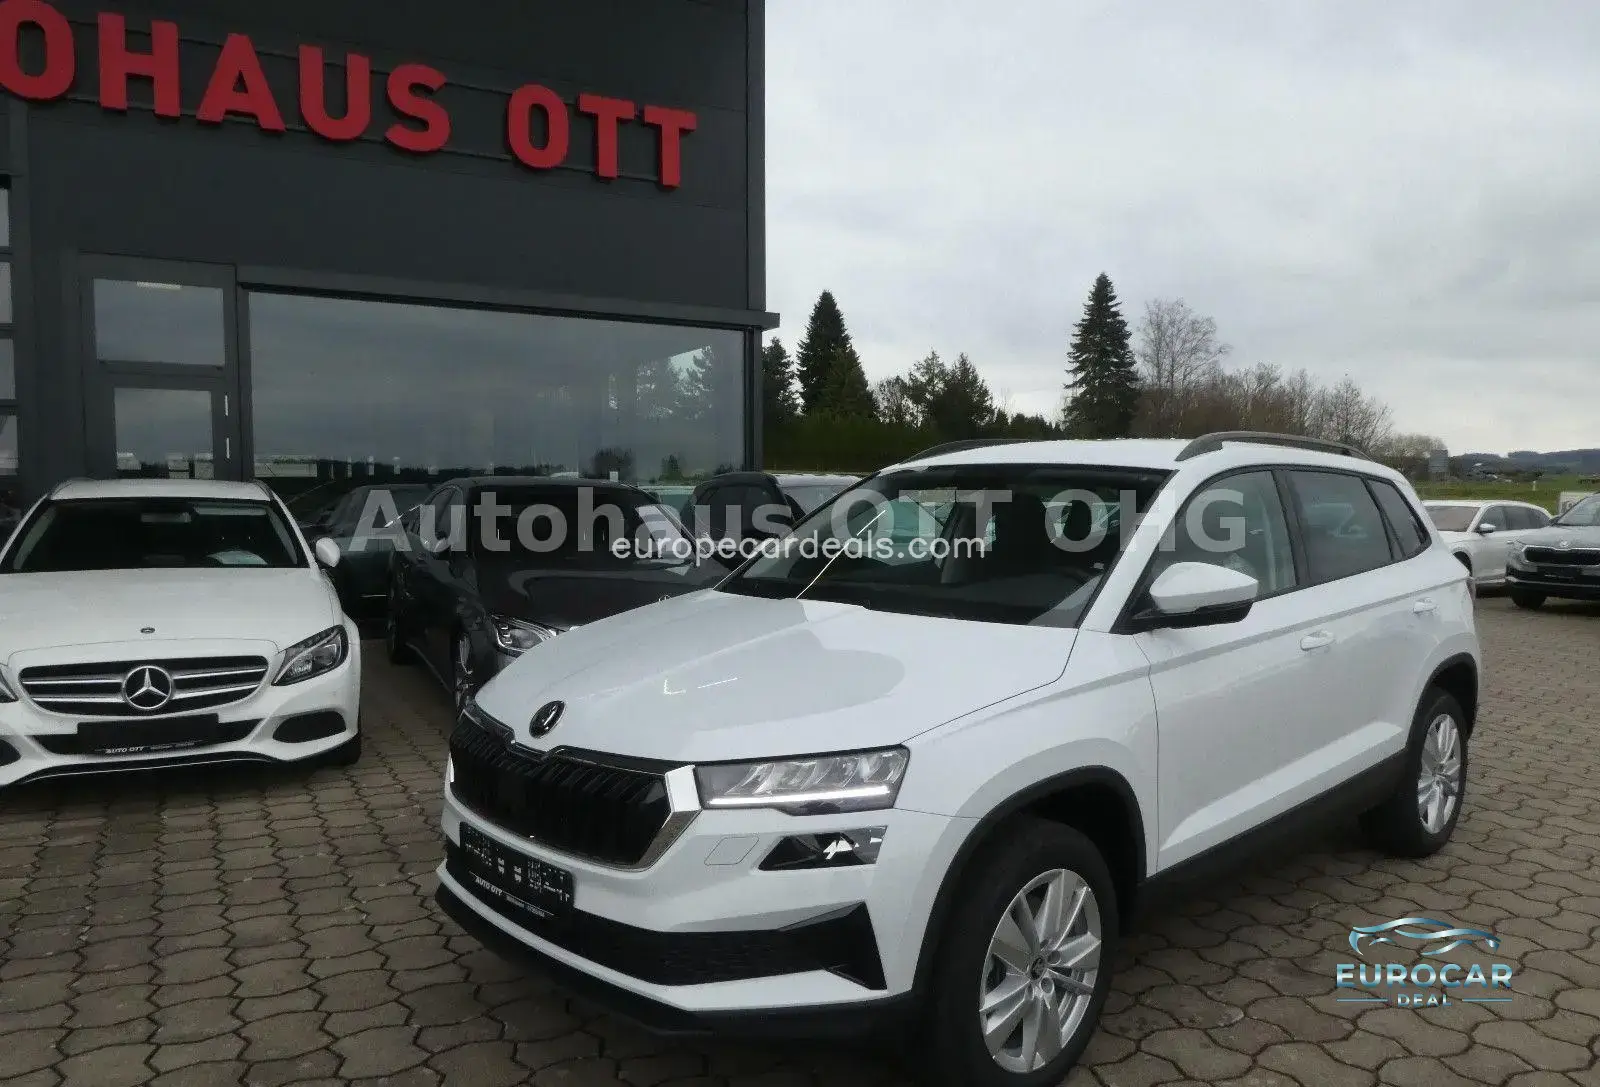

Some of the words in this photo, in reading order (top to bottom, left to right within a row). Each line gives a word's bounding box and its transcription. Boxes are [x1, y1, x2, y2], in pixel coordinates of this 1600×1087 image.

[0, 0, 451, 153] OHAUS
[508, 84, 697, 188] OTT
[475, 876, 490, 890] AUTO
